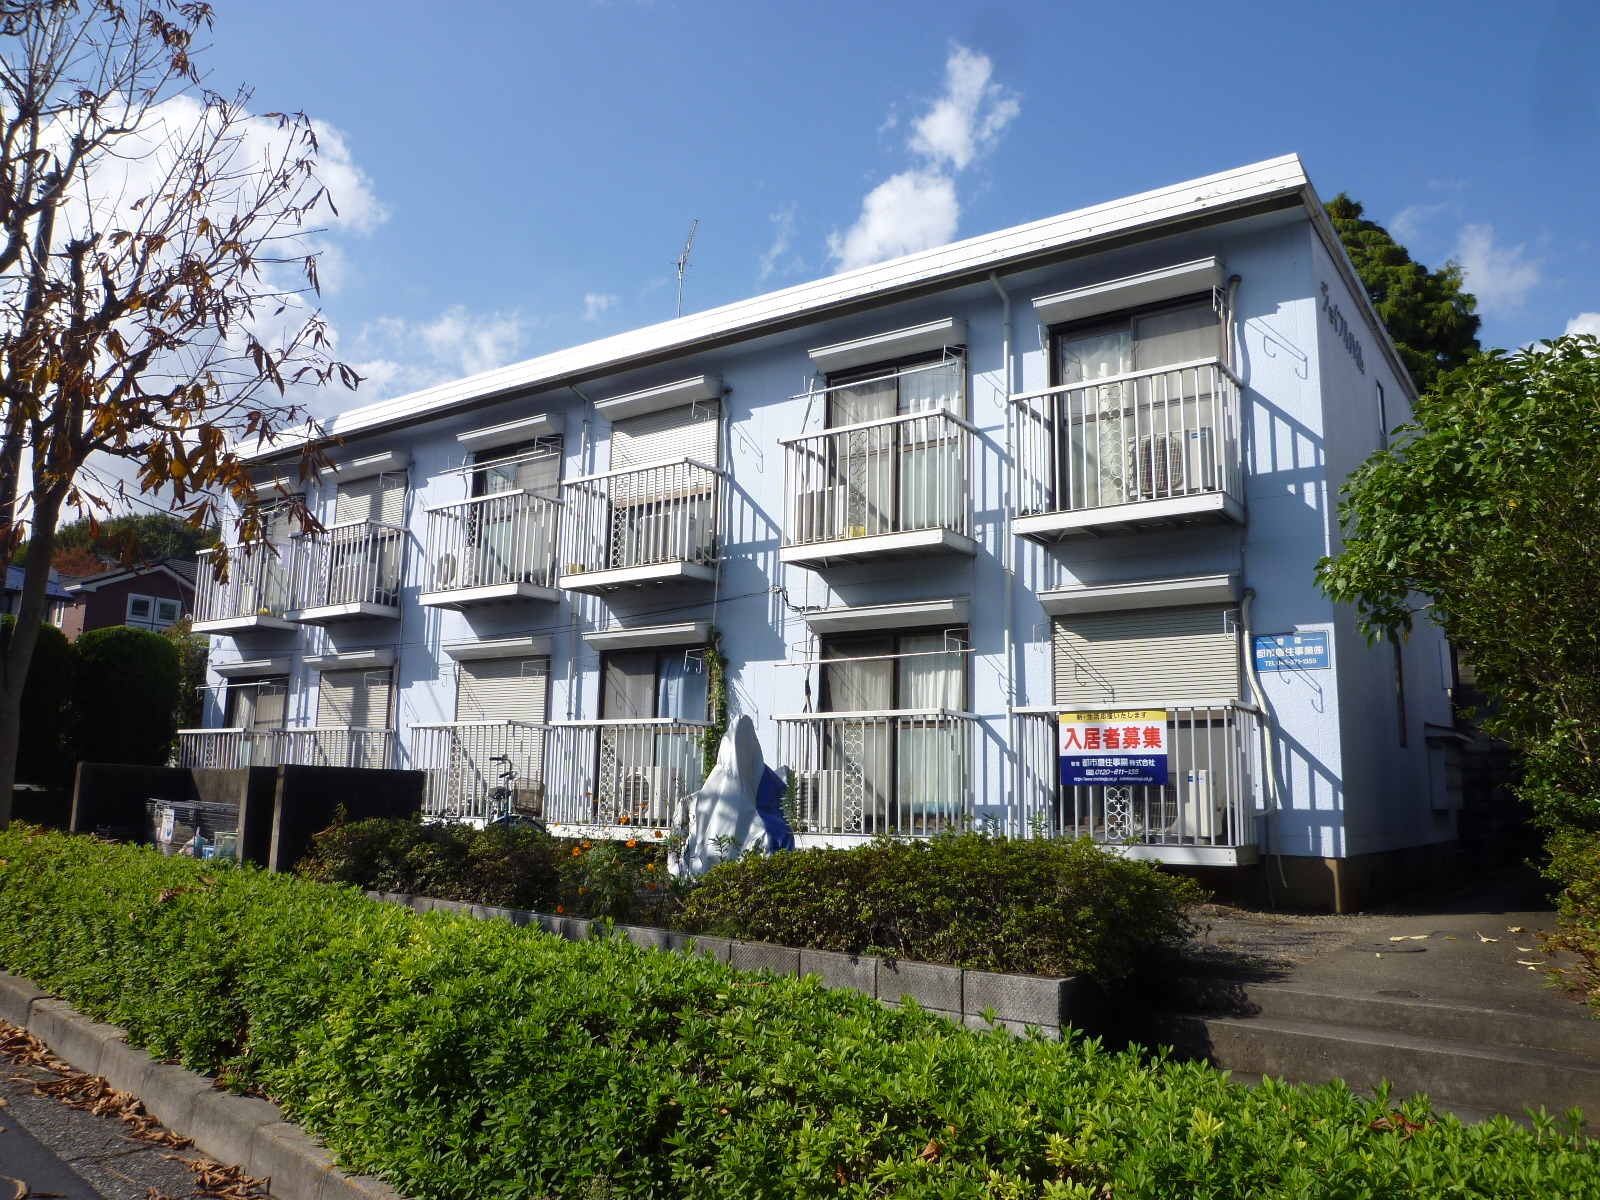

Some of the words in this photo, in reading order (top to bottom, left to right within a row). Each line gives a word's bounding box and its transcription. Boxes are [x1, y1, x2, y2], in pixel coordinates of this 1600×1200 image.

[1064, 726, 1162, 750] 入居者募集
